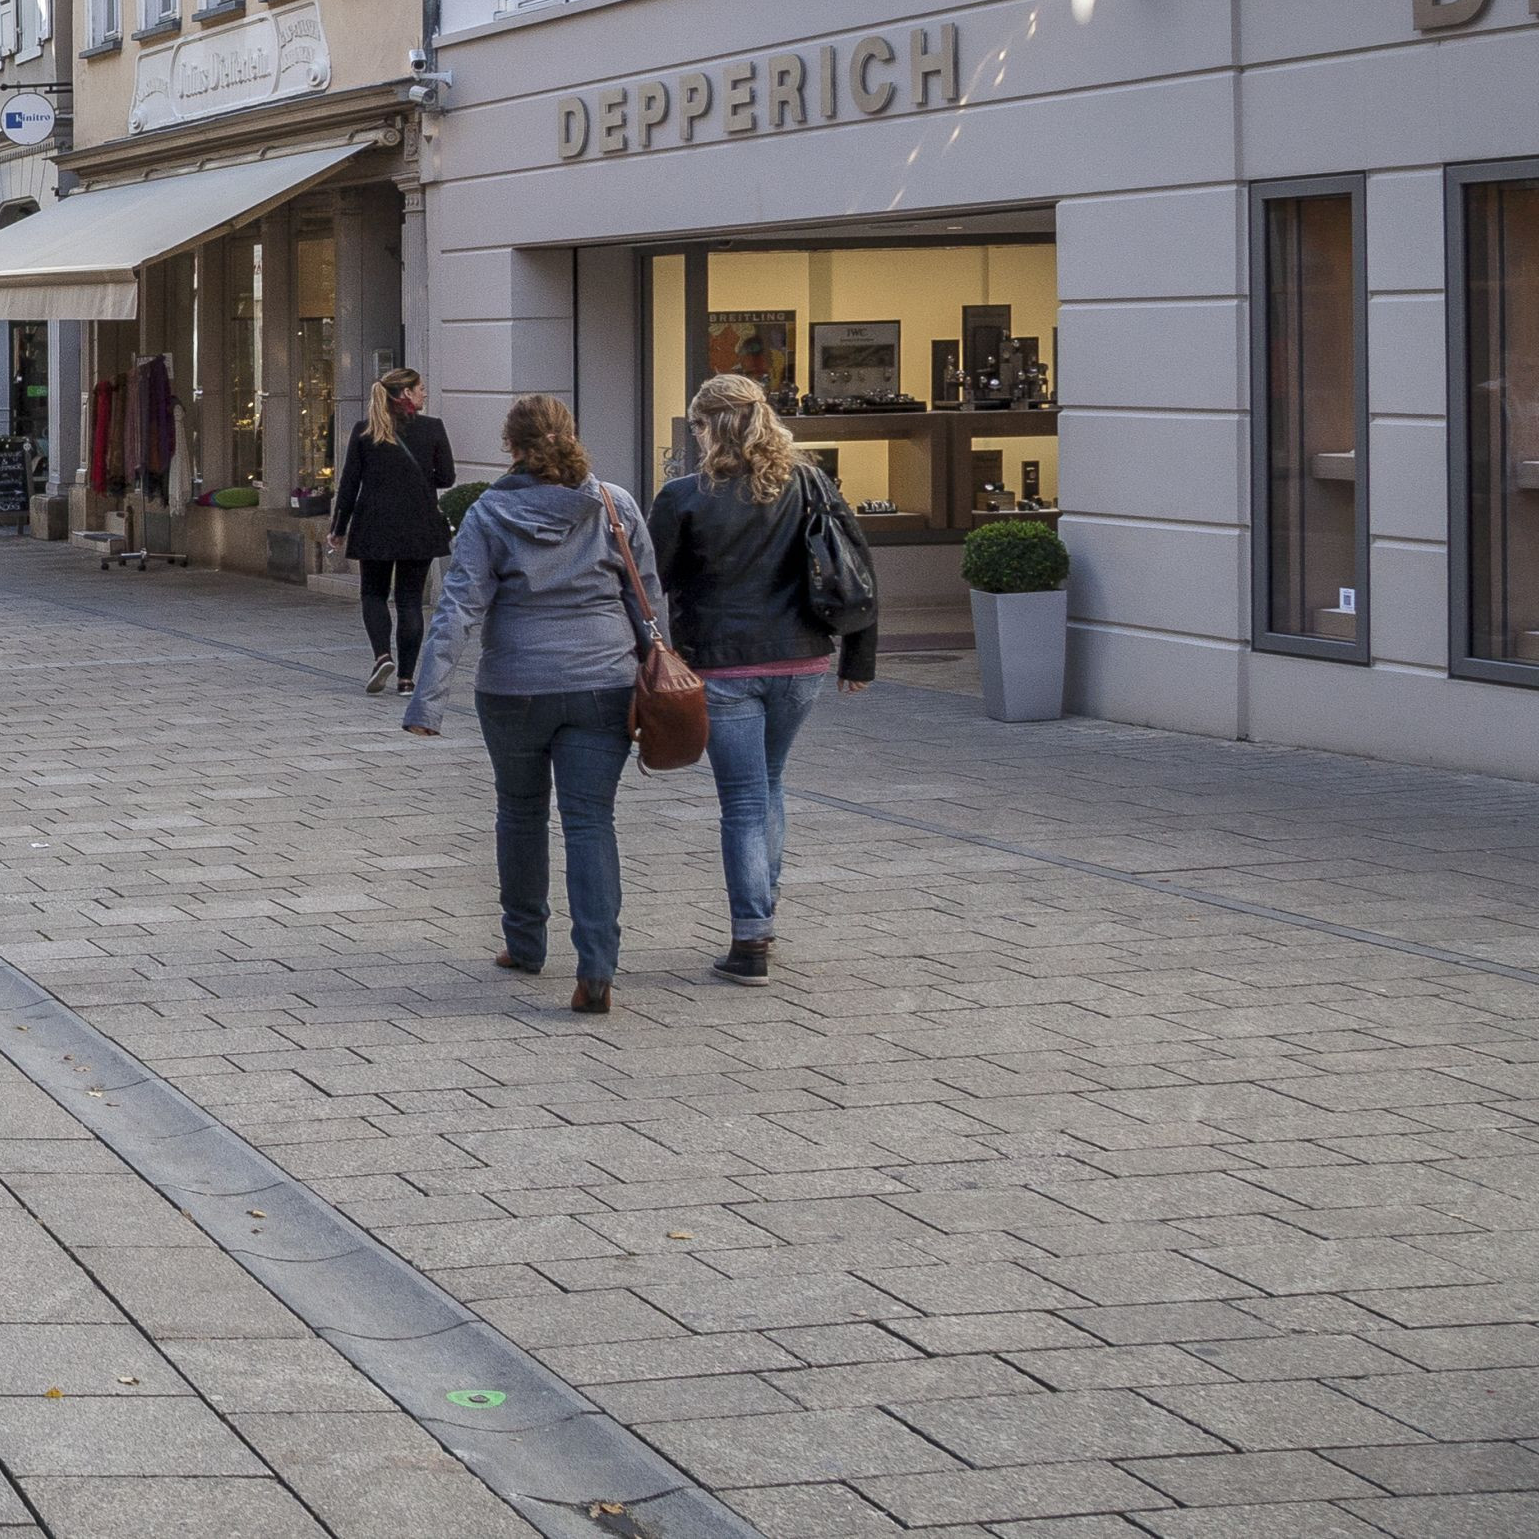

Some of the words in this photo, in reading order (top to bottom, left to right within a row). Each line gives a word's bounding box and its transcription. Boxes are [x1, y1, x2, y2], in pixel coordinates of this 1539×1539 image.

[557, 22, 959, 160] DEPPERICH
[709, 312, 786, 322] BREITLING
[846, 328, 868, 337] IWC
